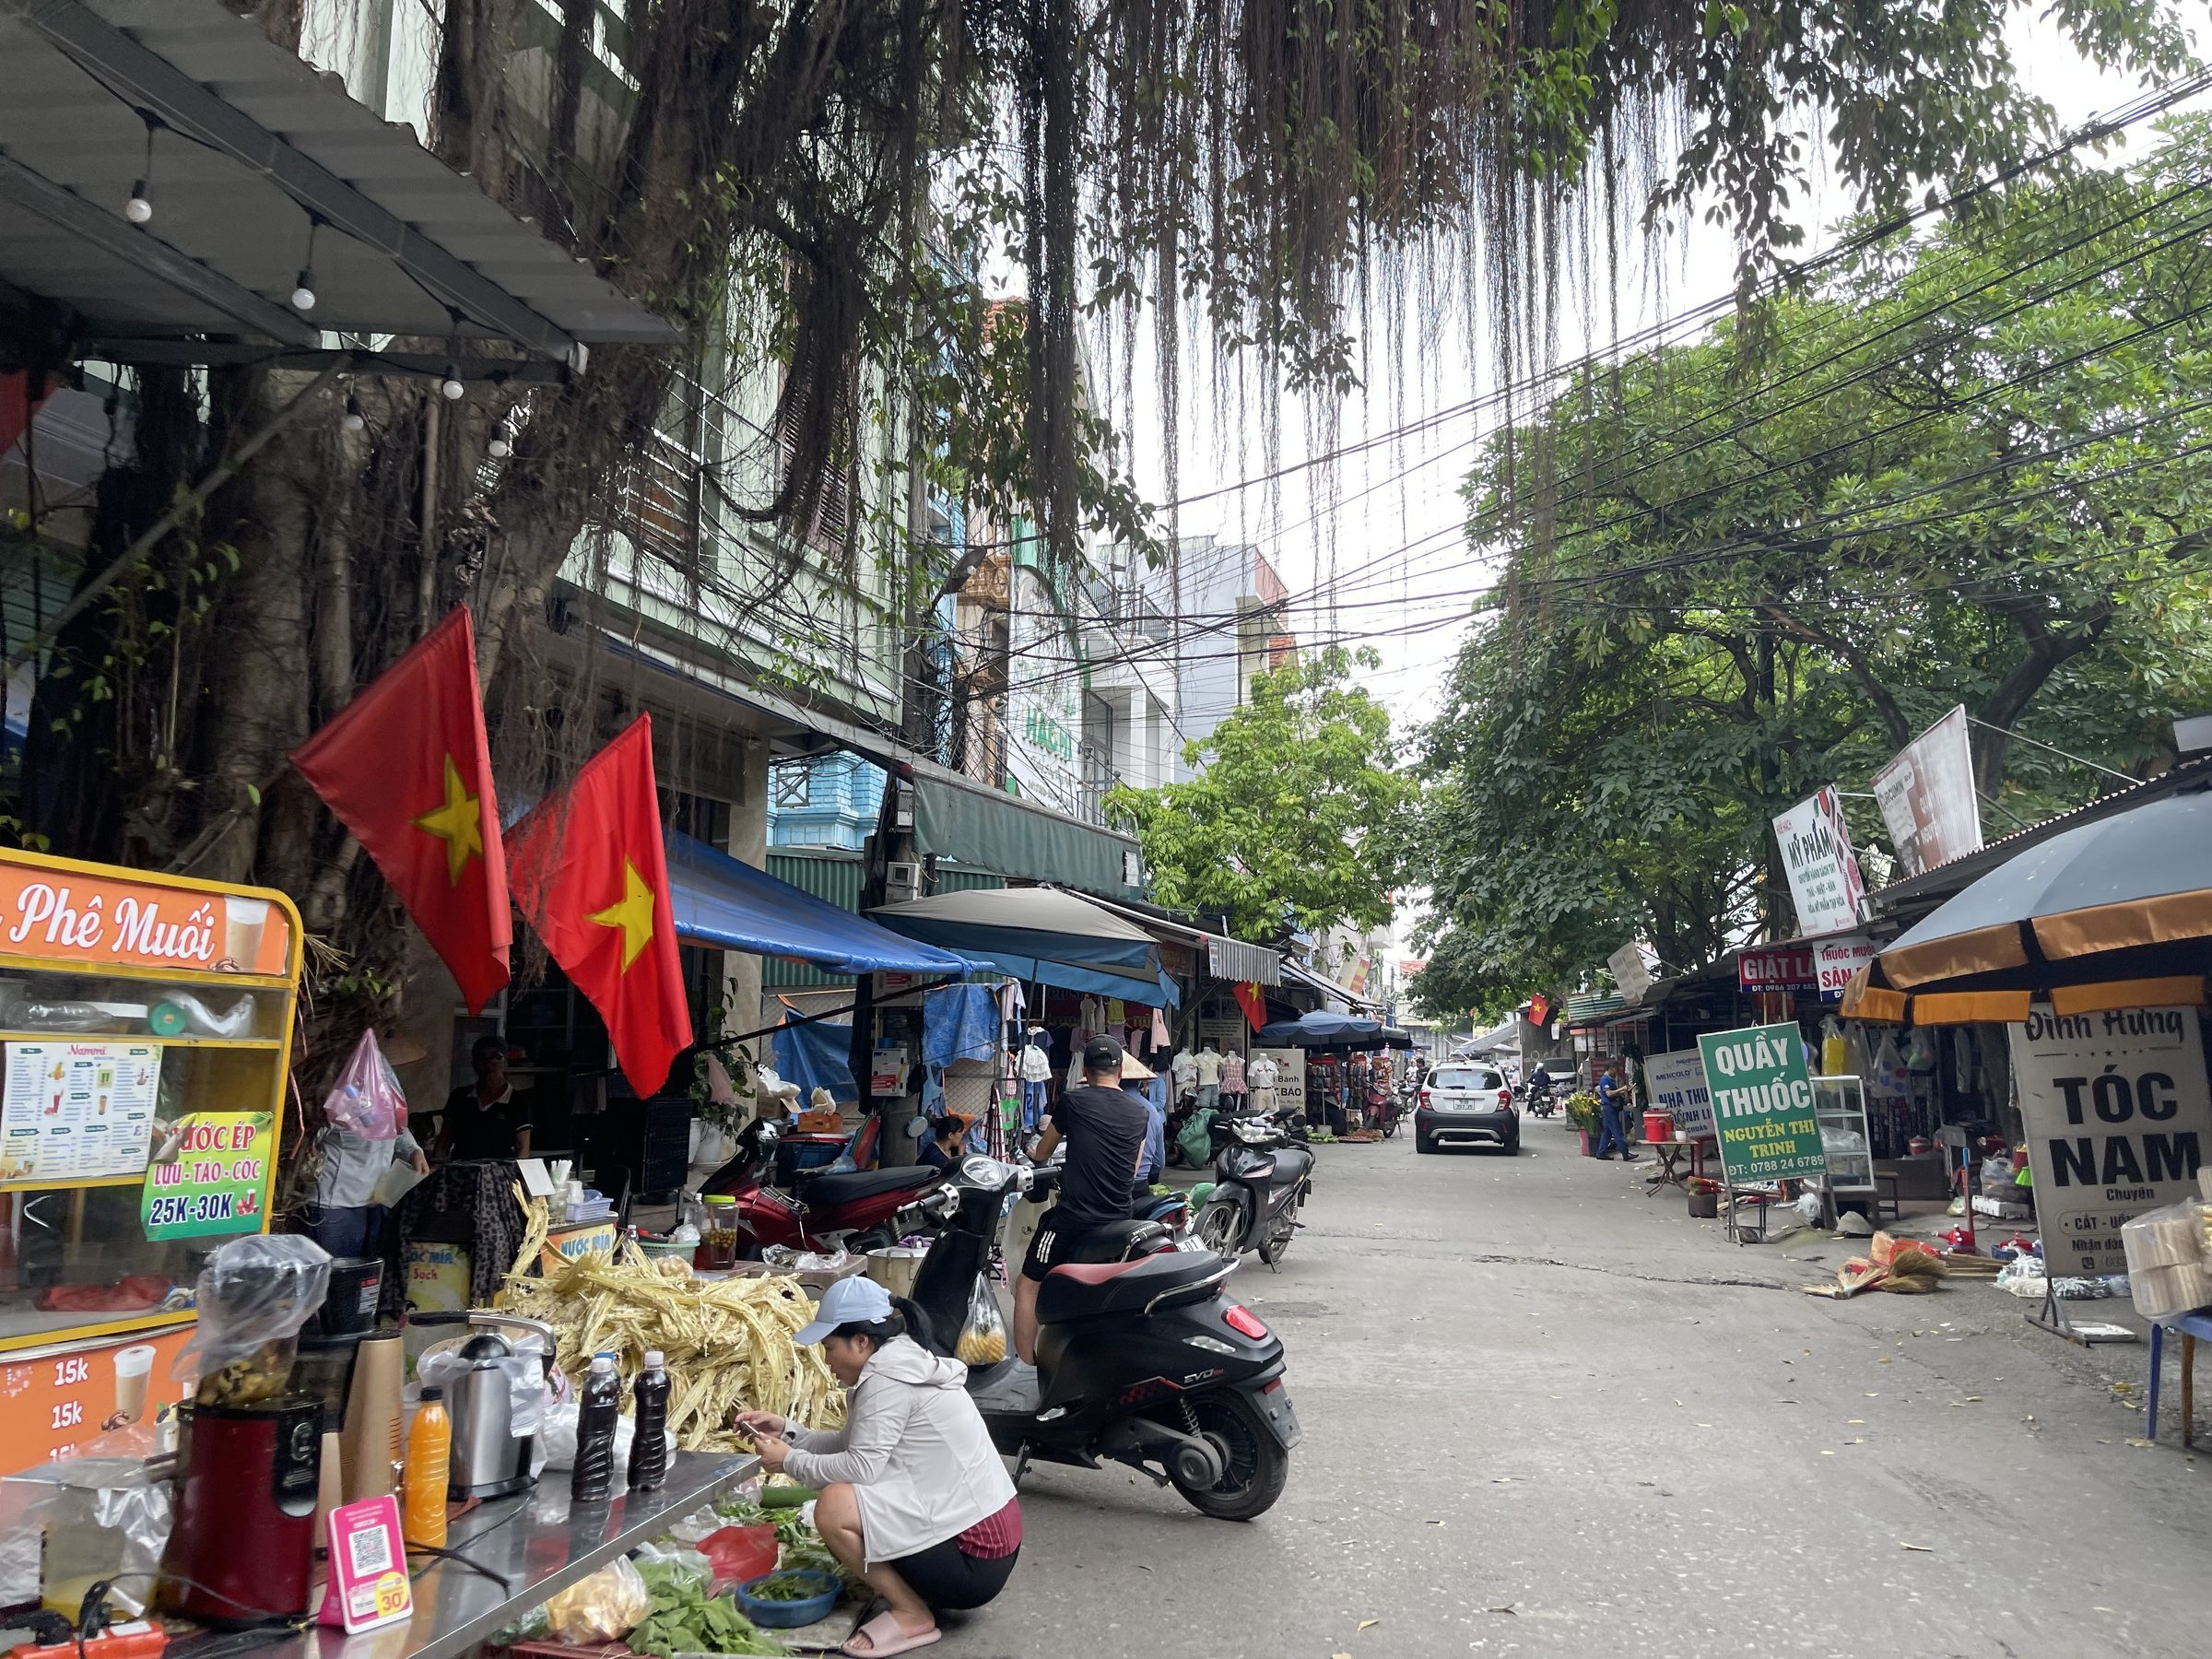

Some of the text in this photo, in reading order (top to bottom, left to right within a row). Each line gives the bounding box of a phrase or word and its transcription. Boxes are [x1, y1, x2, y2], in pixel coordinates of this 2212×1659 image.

[1788, 832, 1804, 869] MỸ
[1801, 818, 1834, 864] PHẨM
[9, 883, 217, 961] Phê Muối
[1744, 954, 1789, 983] GIẶT
[1822, 966, 1853, 988] SÂN
[2025, 1009, 2092, 1041] Đình
[1714, 1031, 1790, 1077] QUẦY
[1659, 1087, 1684, 1108] NHÀ
[1714, 1071, 1811, 1118] THUỐC
[2053, 1064, 2178, 1124] TÓC
[172, 1120, 256, 1151] ƯỚC ÉP
[1724, 1117, 1816, 1142] NGUYỄN THỊ
[1749, 1139, 1797, 1159] TRINH
[2049, 1132, 2201, 1187] NAM
[194, 1158, 221, 1183] TÁO
[233, 1156, 261, 1181] CÓC
[1728, 1154, 1825, 1176] ĐT: 0788 24 6789
[149, 1192, 233, 1225] 25K-30K
[2107, 1187, 2155, 1202] Chuyên
[1132, 1224, 1156, 1236] HONDA
[2075, 1212, 2097, 1230] CẮT
[560, 1232, 590, 1257] NƯỚC
[2072, 1238, 2101, 1253] Nhận
[53, 1357, 89, 1386] 15k
[51, 1401, 83, 1430] 15k
[382, 1593, 403, 1611] 30
